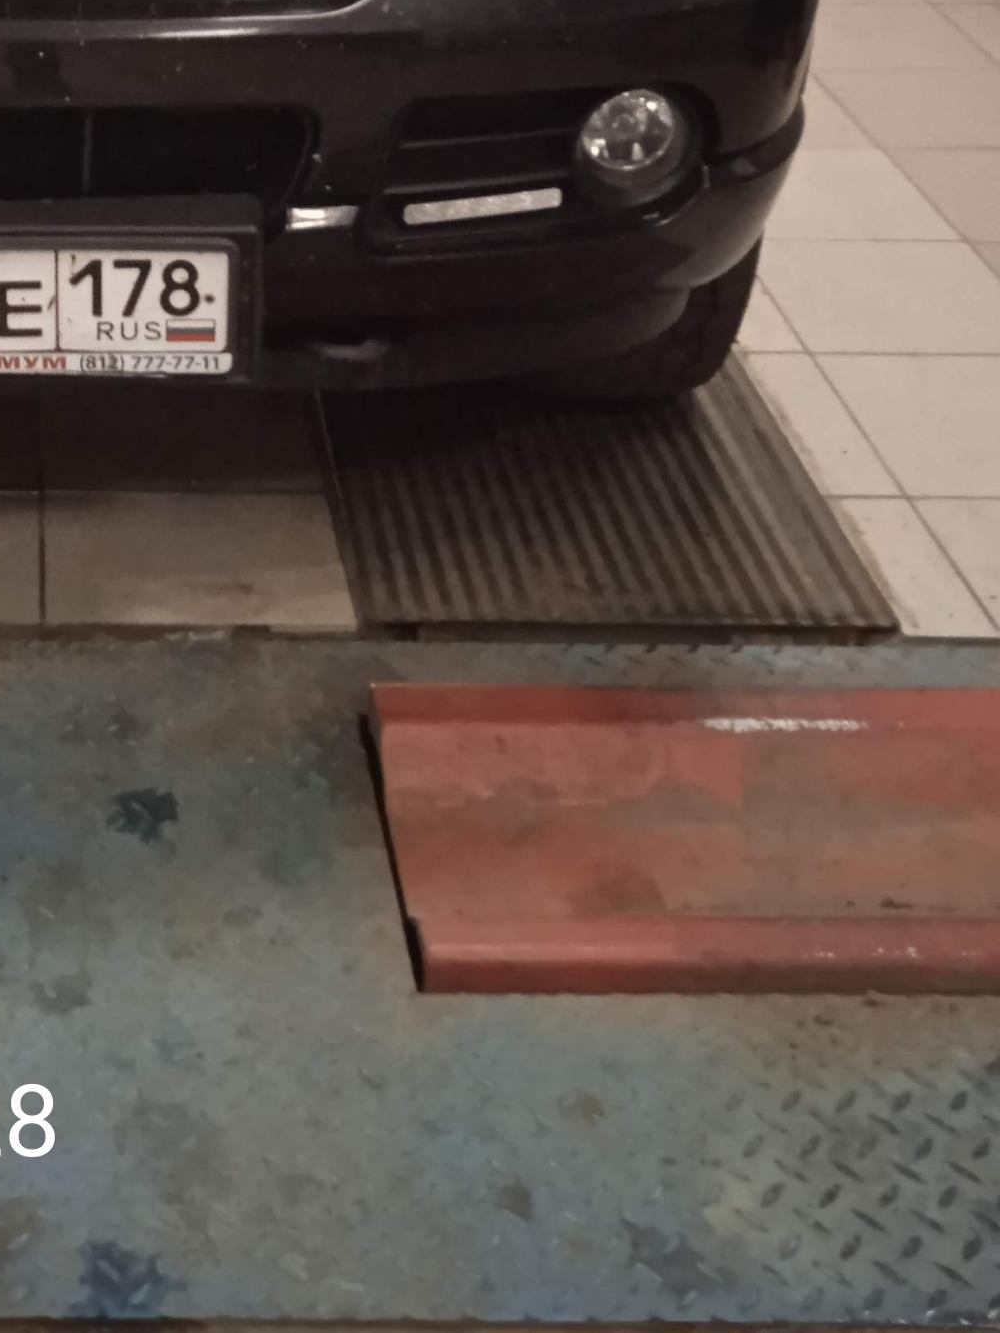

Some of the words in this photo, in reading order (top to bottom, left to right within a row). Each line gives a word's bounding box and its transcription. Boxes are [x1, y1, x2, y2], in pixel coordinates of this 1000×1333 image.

[67, 258, 200, 318] 178
[95, 320, 162, 342] RUS
[79, 354, 125, 373] (812)
[131, 354, 221, 371] 777-77-11
